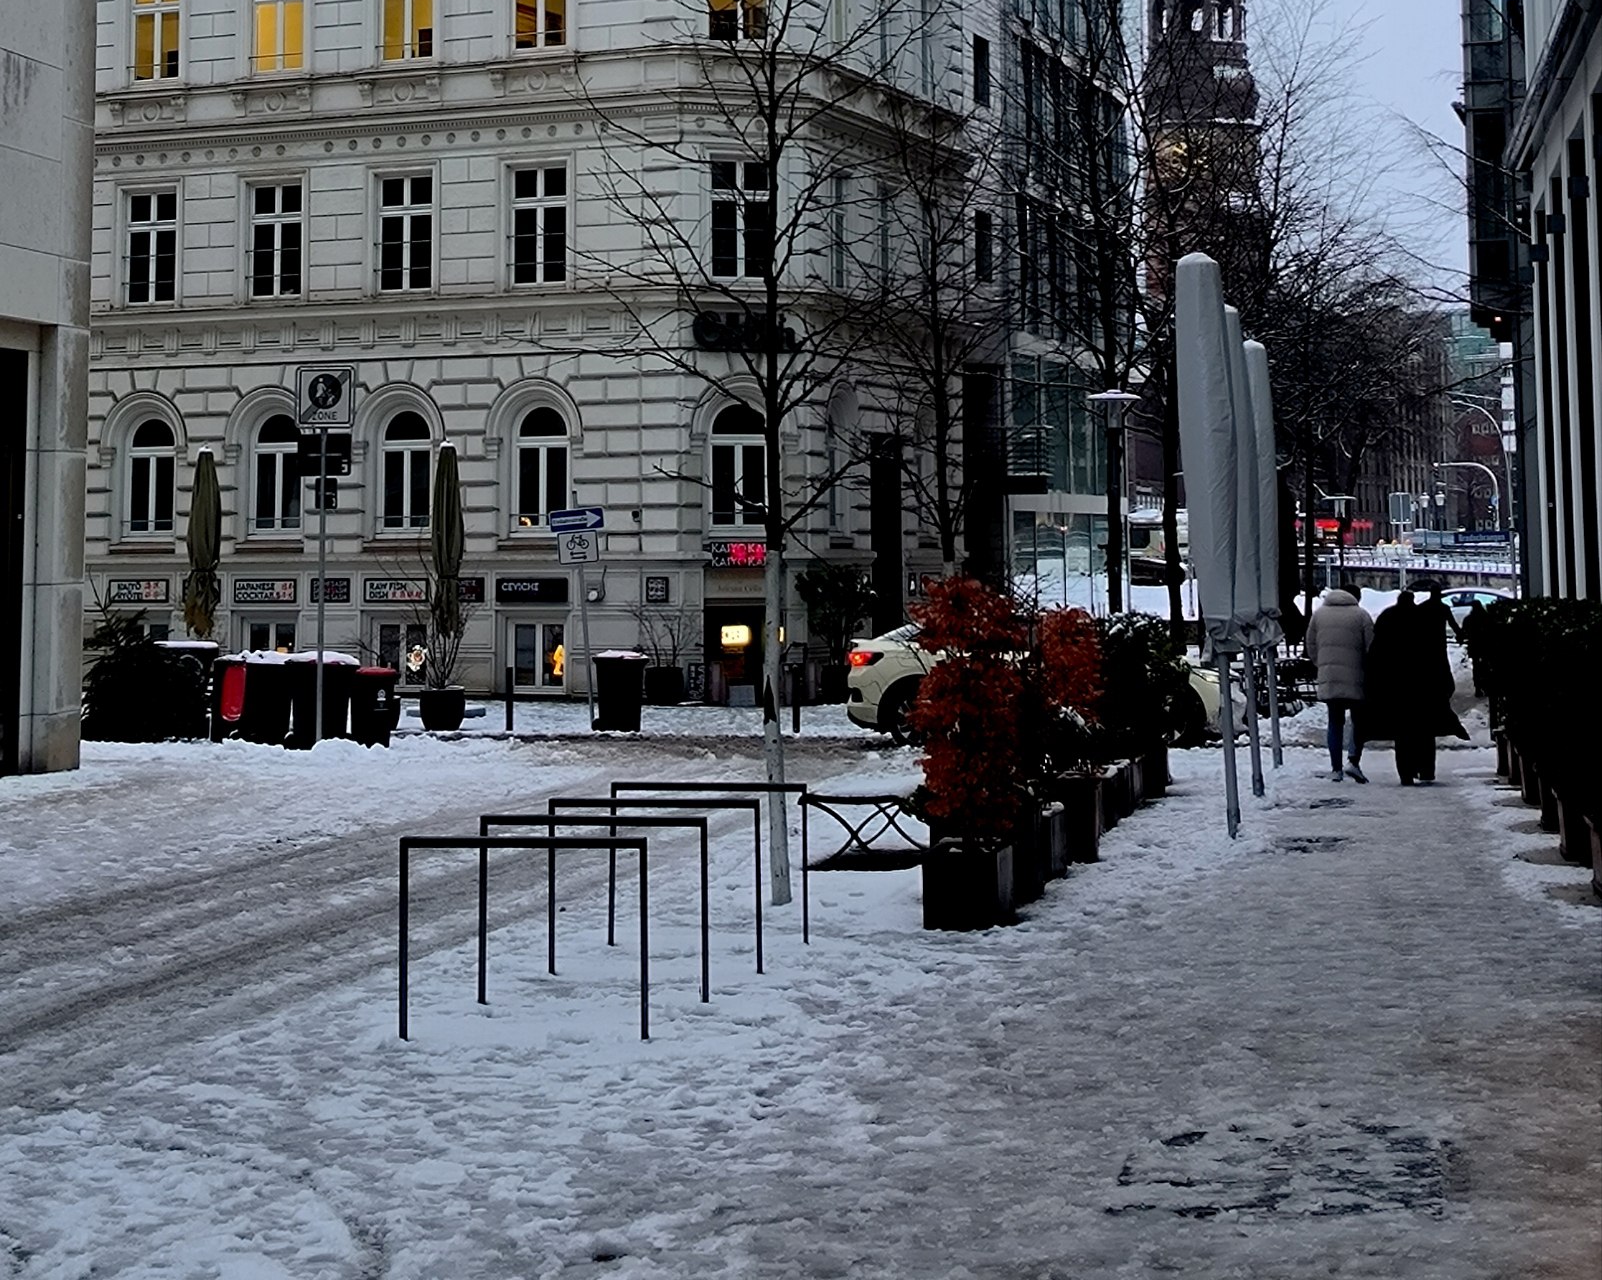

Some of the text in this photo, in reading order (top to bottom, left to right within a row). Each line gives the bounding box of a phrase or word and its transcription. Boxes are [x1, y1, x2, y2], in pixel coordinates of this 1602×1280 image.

[312, 411, 338, 420] ZONE
[236, 583, 275, 591] JAPANESE
[369, 583, 407, 591] RAW FISH
